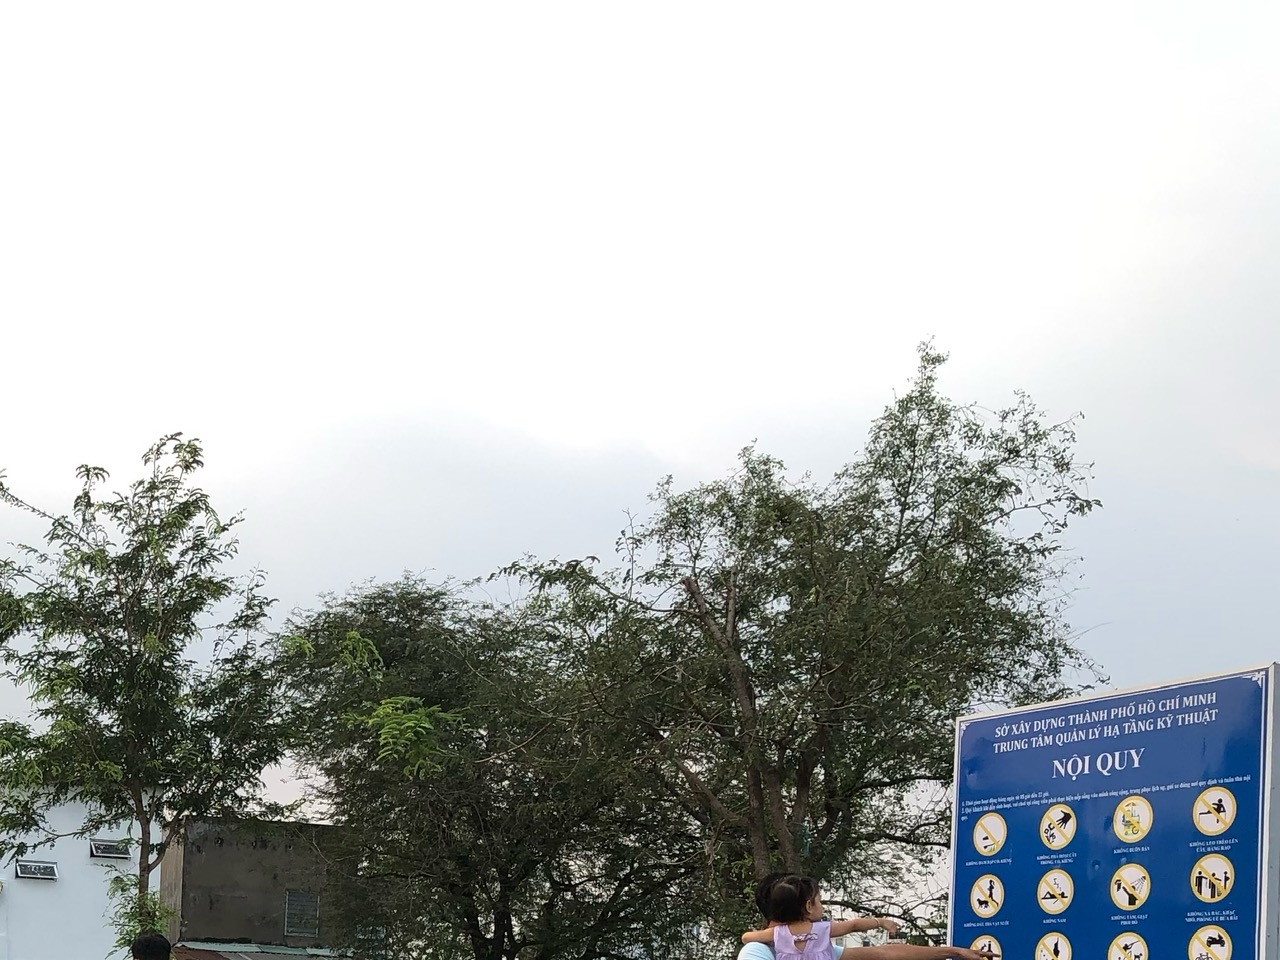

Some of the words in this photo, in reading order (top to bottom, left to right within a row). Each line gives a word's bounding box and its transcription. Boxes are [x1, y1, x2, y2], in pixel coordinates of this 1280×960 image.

[993, 738, 1028, 753] TRUNG
[1030, 734, 1053, 748] TÂM
[1055, 728, 1086, 746] QUẢN
[1089, 724, 1102, 739] LÝ
[1103, 724, 1120, 738] HẠ
[1123, 718, 1154, 734] TẦNG
[1156, 714, 1174, 730] KỸ
[1176, 708, 1218, 725] THUẬT
[995, 723, 1010, 738] SỞ
[1011, 721, 1031, 735] XÂY
[1033, 717, 1065, 732] DỰNG
[1068, 709, 1108, 726] THÀNH
[1110, 701, 1136, 719] PHỐ
[1138, 699, 1156, 715] HỒ
[1158, 695, 1180, 711] CHÍ
[1182, 692, 1217, 708] MINH
[1052, 754, 1091, 781] NỘI
[1096, 748, 1145, 776] QUY
